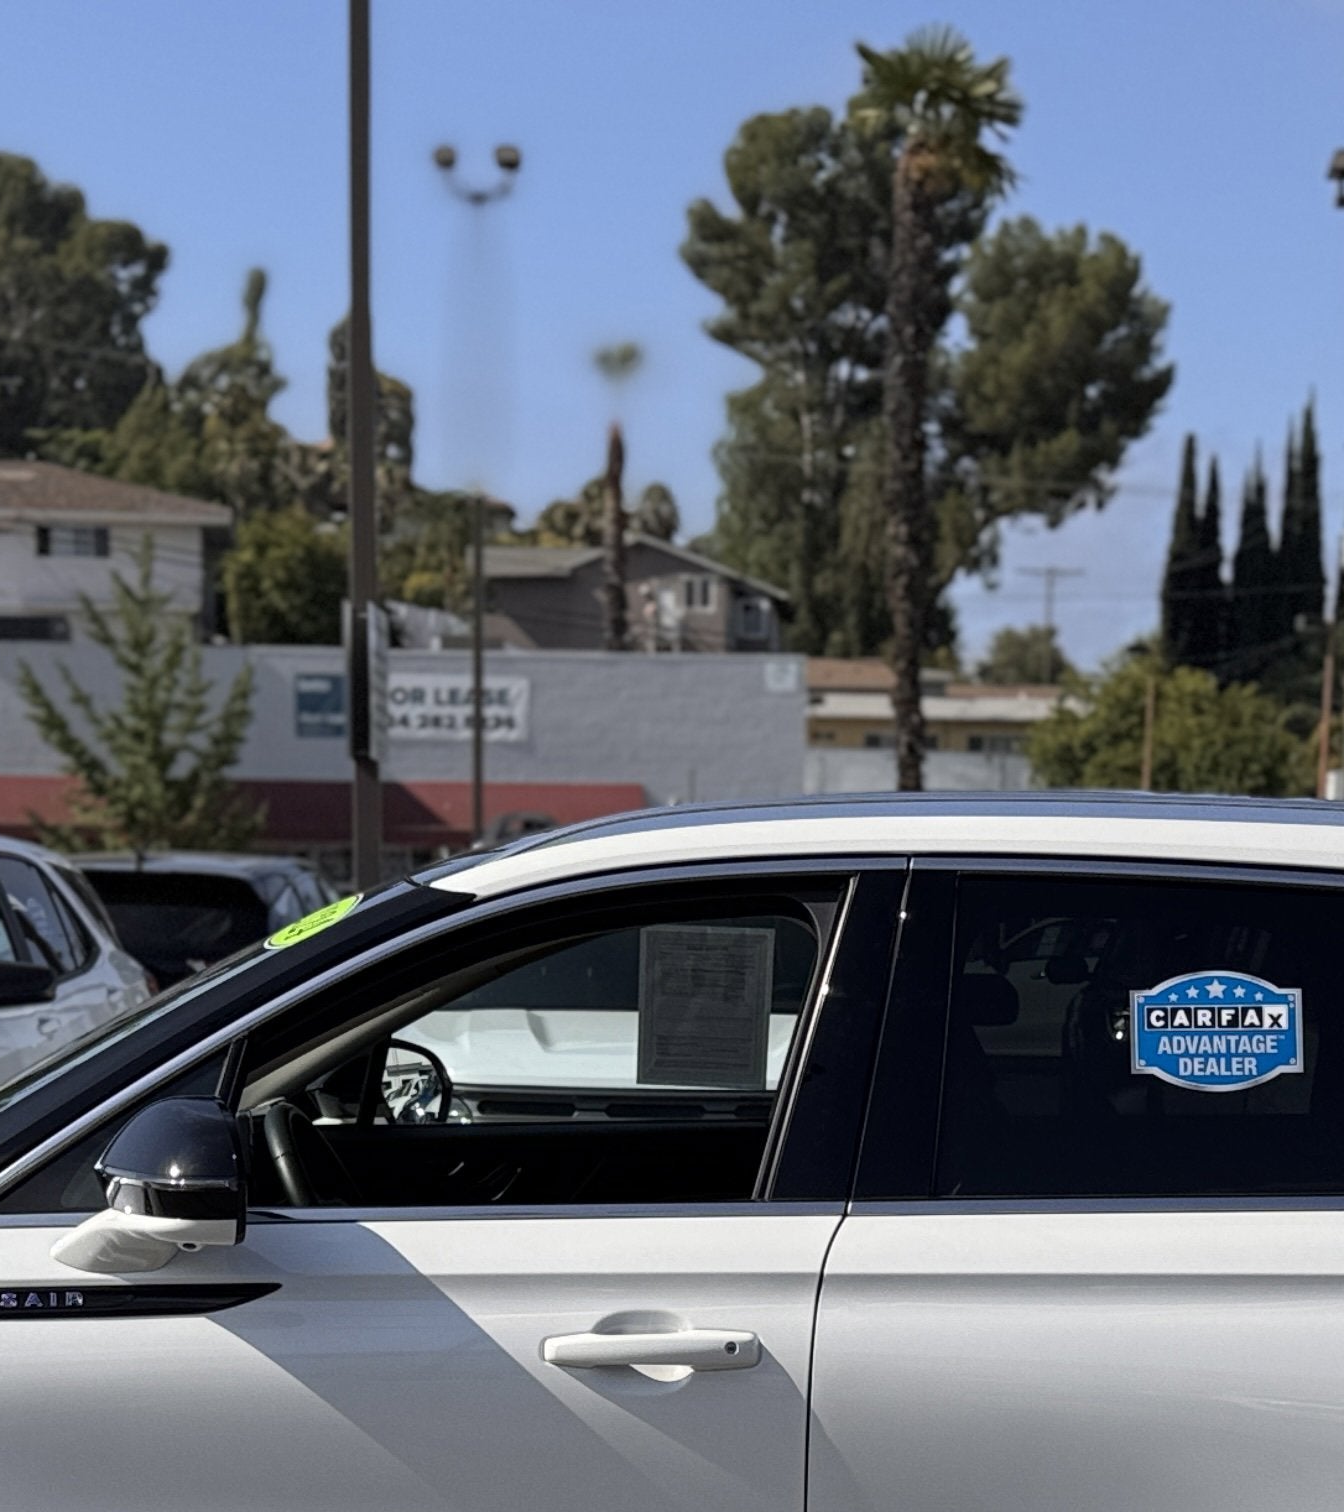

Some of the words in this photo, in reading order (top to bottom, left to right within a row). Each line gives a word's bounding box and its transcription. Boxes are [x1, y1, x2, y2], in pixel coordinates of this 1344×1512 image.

[390, 687, 425, 705] OR
[1149, 1006, 1284, 1028] CARFAX
[1179, 1056, 1258, 1076] DEALER
